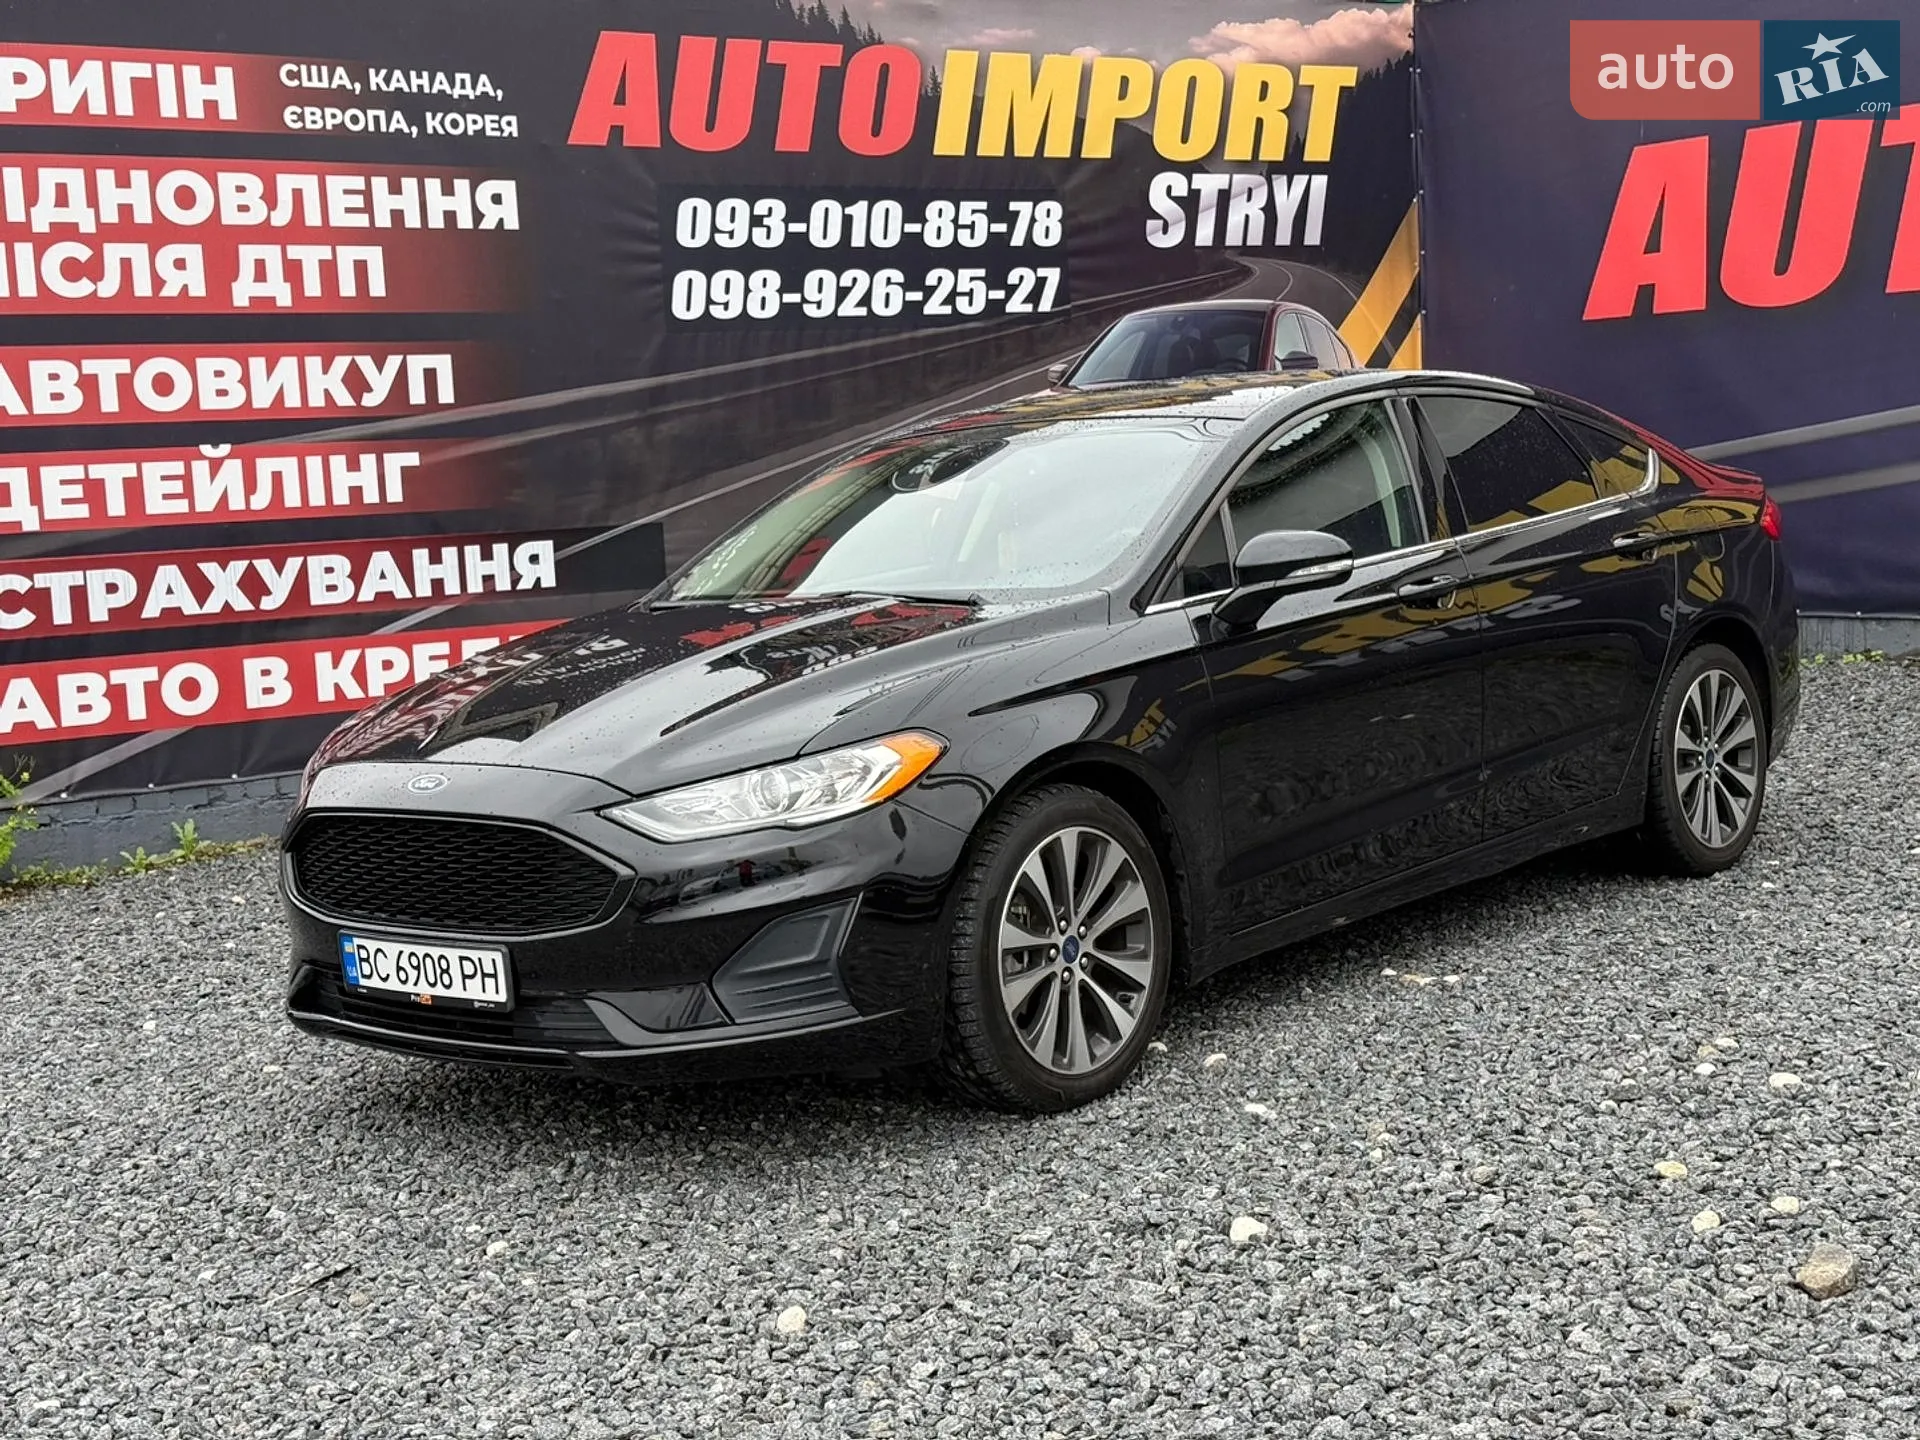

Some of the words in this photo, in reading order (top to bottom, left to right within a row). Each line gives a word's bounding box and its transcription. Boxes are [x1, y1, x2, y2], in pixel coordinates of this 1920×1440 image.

[279, 63, 361, 95] США,
[368, 68, 504, 101] КАНАДА,
[567, 30, 922, 155] AUTO
[932, 50, 1358, 162] IMPORT
[283, 105, 418, 138] ЄВРОПА,
[425, 111, 518, 138] КОРЕЯ
[2, 166, 520, 234] ІДНОВЛЕННЯ
[676, 197, 1063, 249] 093-010-85-78
[1146, 172, 1328, 249] STRYI
[0, 241, 207, 299] ІСЛЯ
[231, 244, 387, 307] ДТП
[672, 266, 1061, 321] 098-926-25-27
[0, 540, 557, 631] СТРАХУВАННЯ
[0, 662, 220, 733] АВТО
[243, 656, 293, 709] В
[356, 944, 390, 983] BC
[396, 950, 453, 990] 6908
[459, 955, 499, 995] PH
